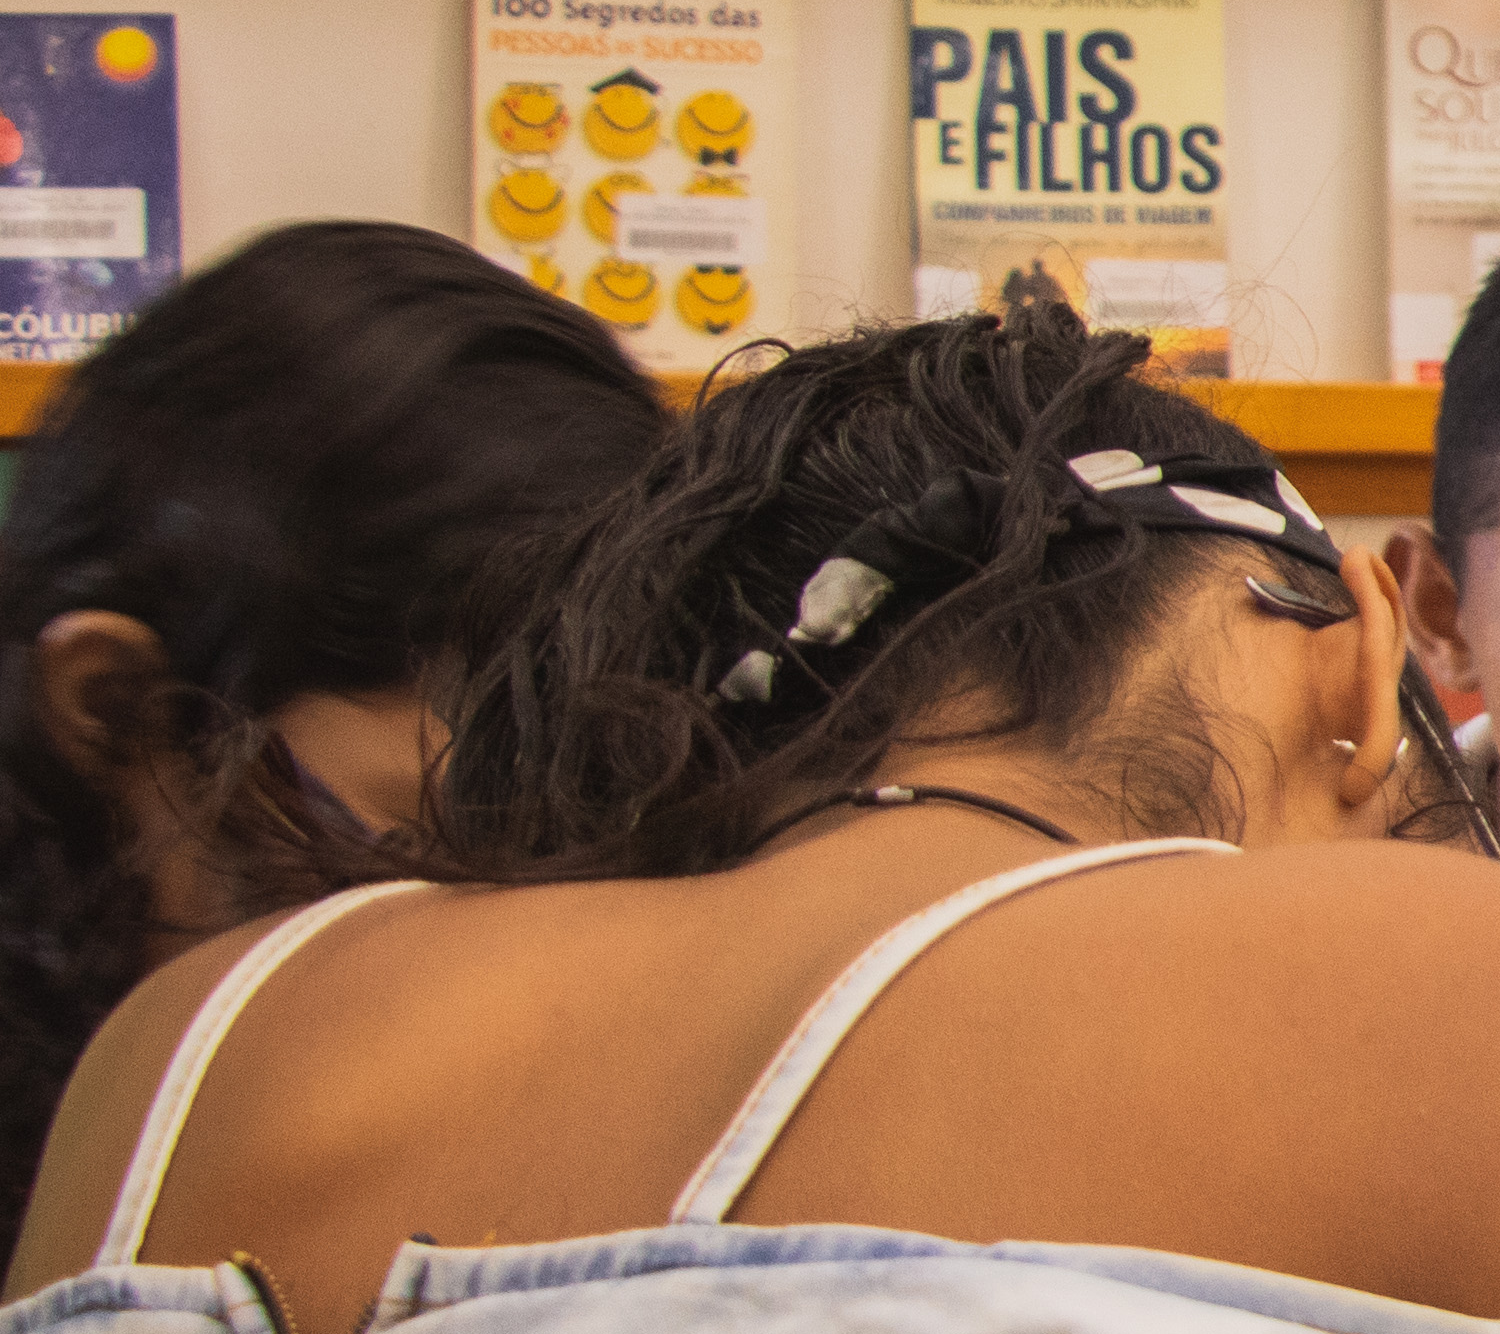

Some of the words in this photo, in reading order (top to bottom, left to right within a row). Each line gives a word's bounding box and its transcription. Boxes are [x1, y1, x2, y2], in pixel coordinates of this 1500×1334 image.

[708, 0, 763, 29] das
[487, 28, 612, 59] PESSOAS
[641, 35, 765, 66] SUCESSO
[910, 26, 1138, 123] PAIS
[939, 119, 965, 166] E
[974, 121, 1225, 195] FILHOS
